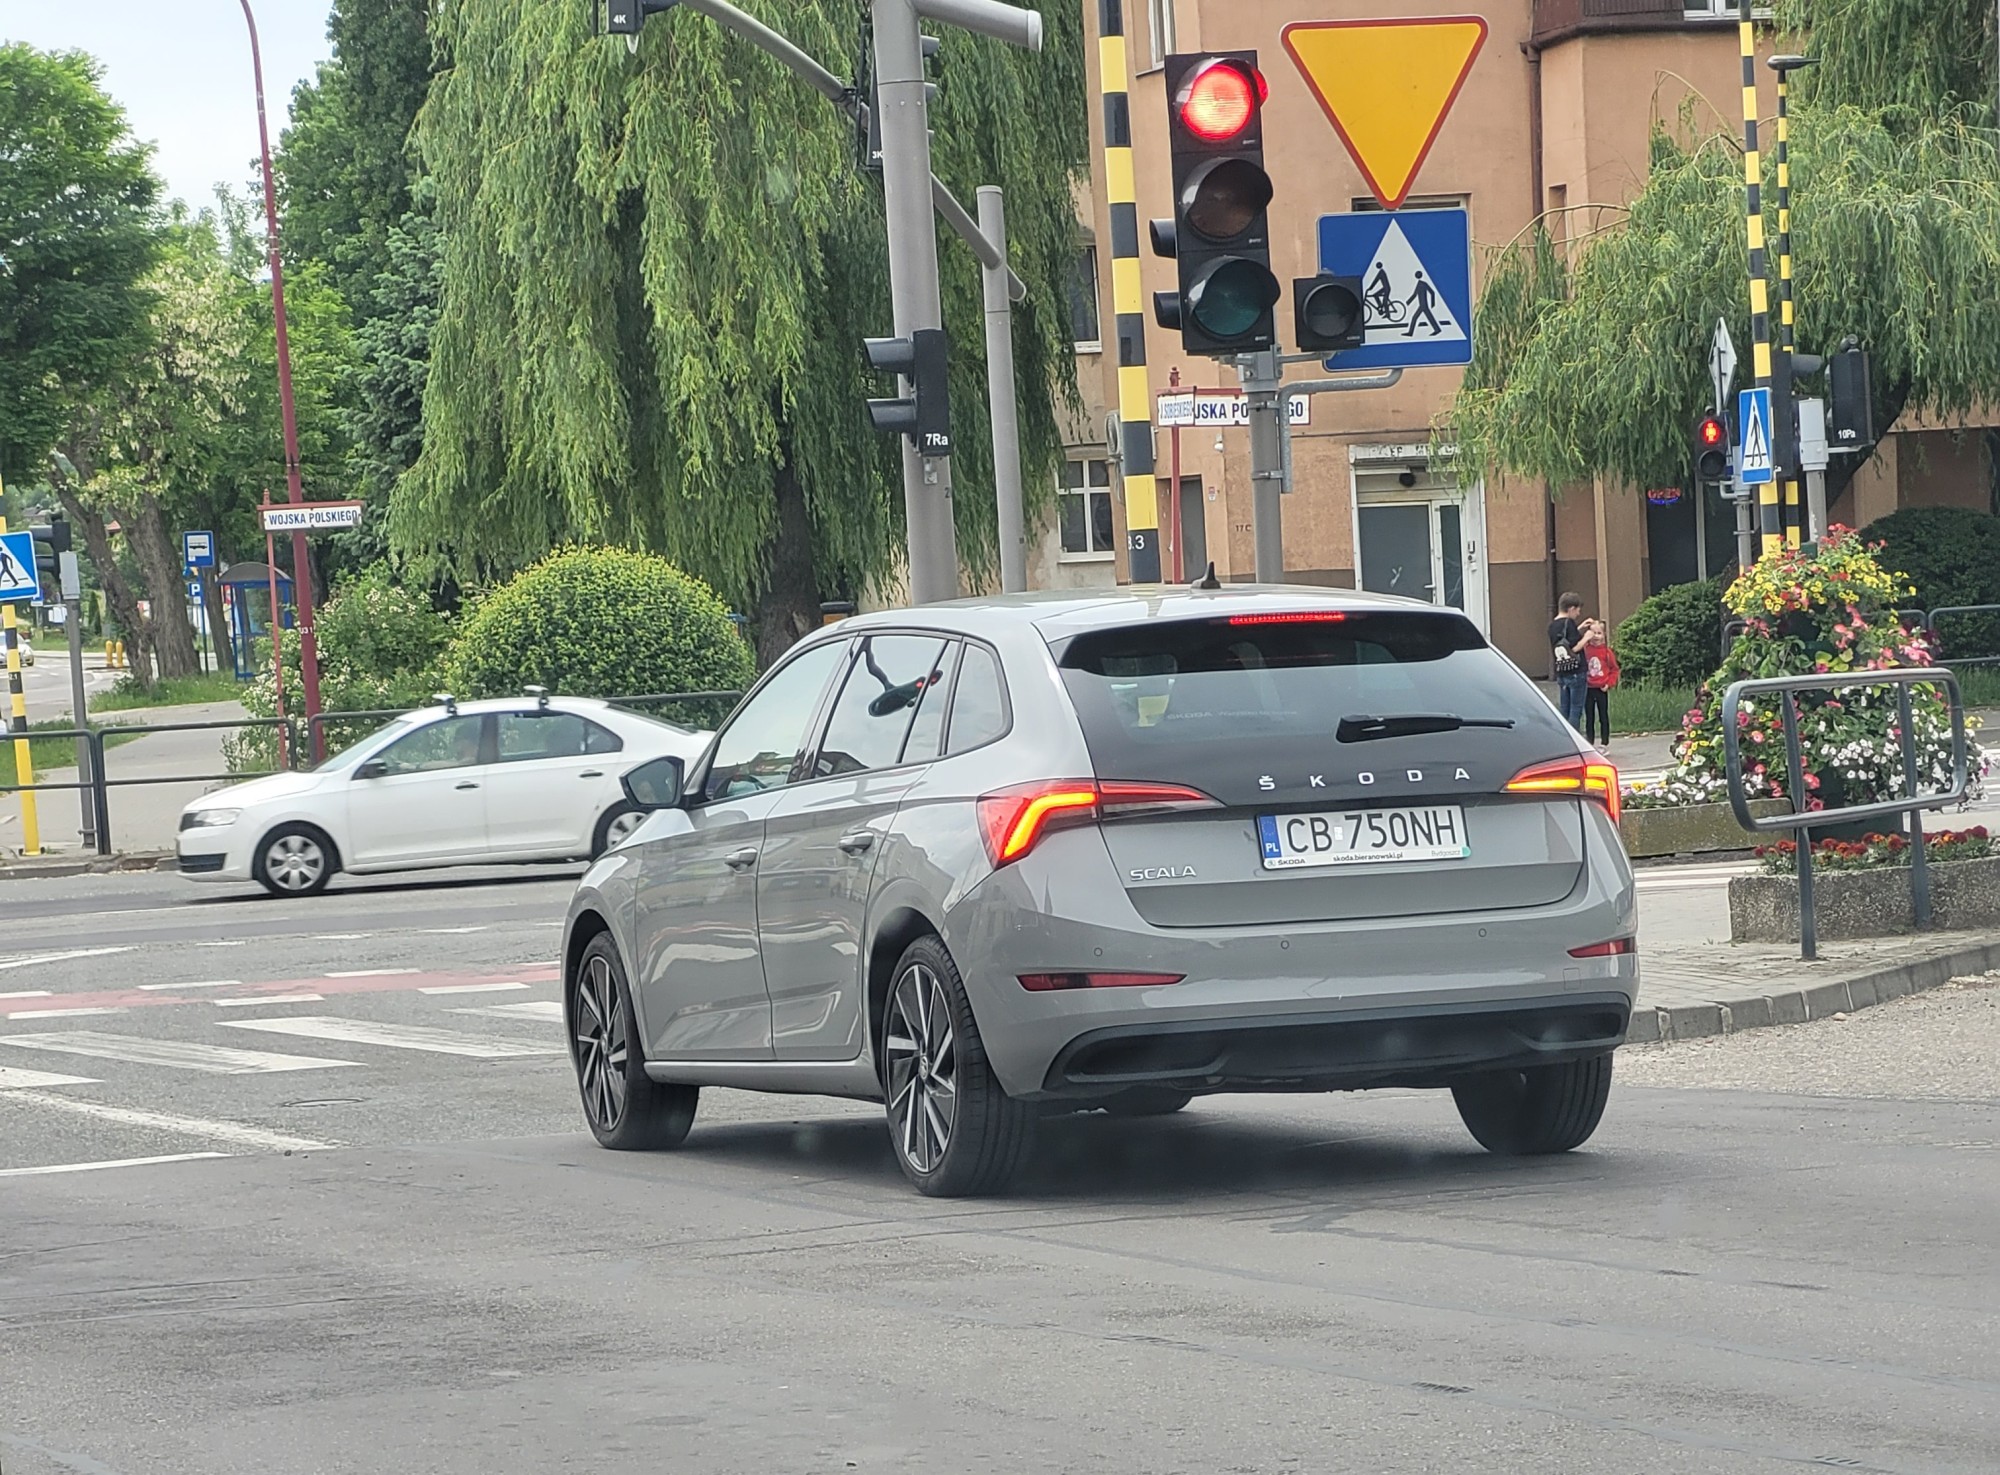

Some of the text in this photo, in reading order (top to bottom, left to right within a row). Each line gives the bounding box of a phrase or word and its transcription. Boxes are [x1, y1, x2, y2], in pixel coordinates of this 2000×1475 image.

[613, 14, 626, 24] 4K
[925, 433, 949, 445] 7Ra
[1838, 429, 1856, 439] 10Pa
[269, 509, 358, 525] WOJSKA POLSKIEGO
[1258, 767, 1470, 790] ŠKODA
[1286, 809, 1457, 853] CB 750NH
[1266, 842, 1279, 853] PL
[1333, 852, 1404, 862] skoda.bieranowski.pl
[1130, 865, 1197, 881] SCALA
